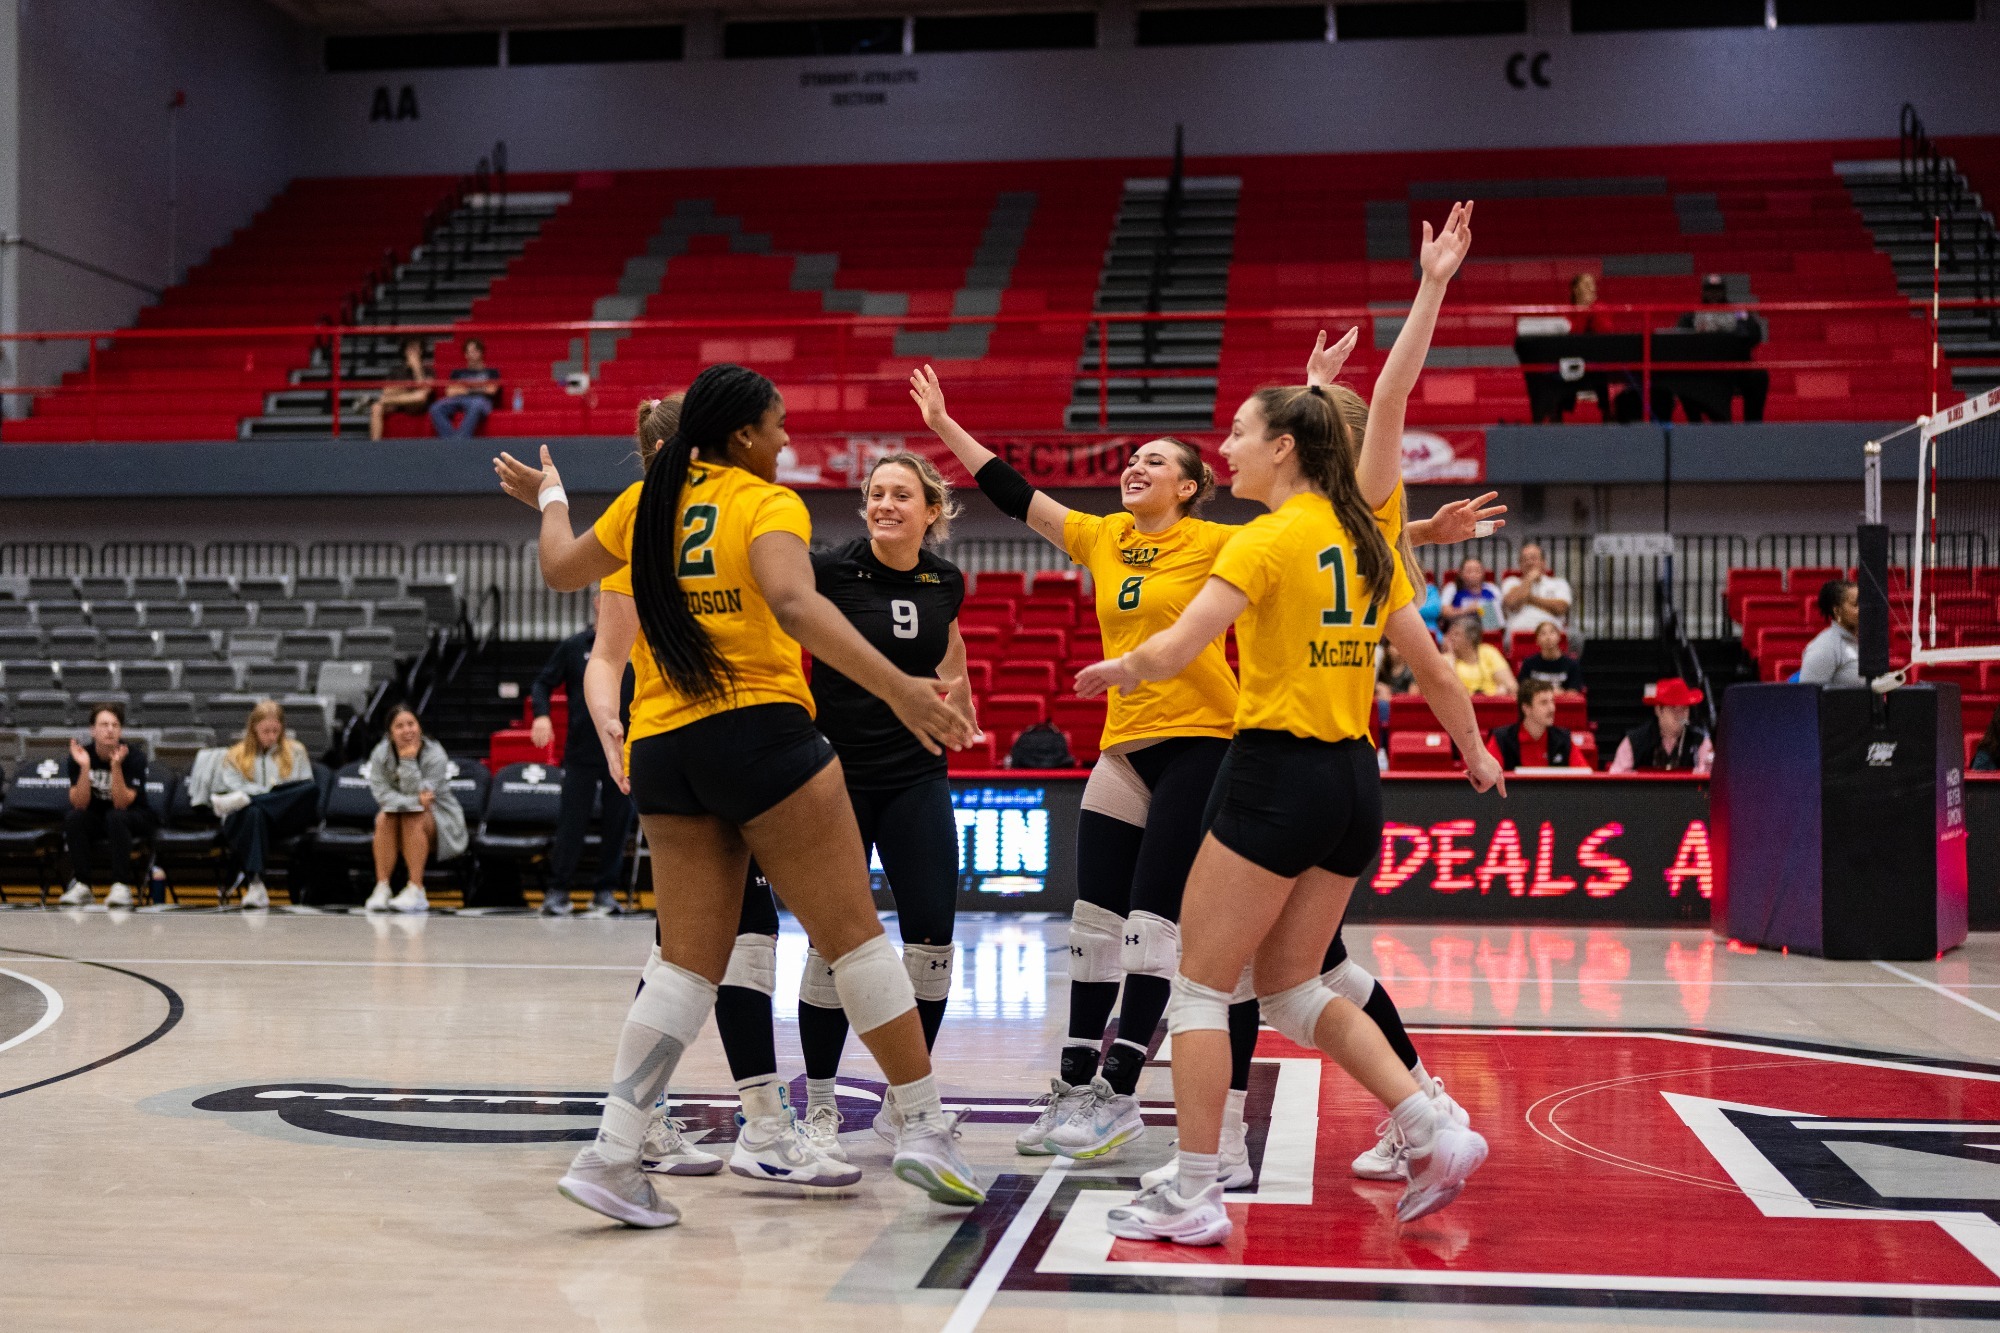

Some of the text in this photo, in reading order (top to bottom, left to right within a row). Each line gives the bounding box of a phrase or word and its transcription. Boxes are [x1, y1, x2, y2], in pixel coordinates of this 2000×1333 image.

[1505, 51, 1551, 90] CC
[370, 85, 419, 122] AA
[986, 440, 1138, 477] ECTIO
[676, 502, 719, 579] 2
[1118, 576, 1145, 611] 8
[891, 599, 919, 639] 9
[1371, 819, 1713, 898] DEALS A
